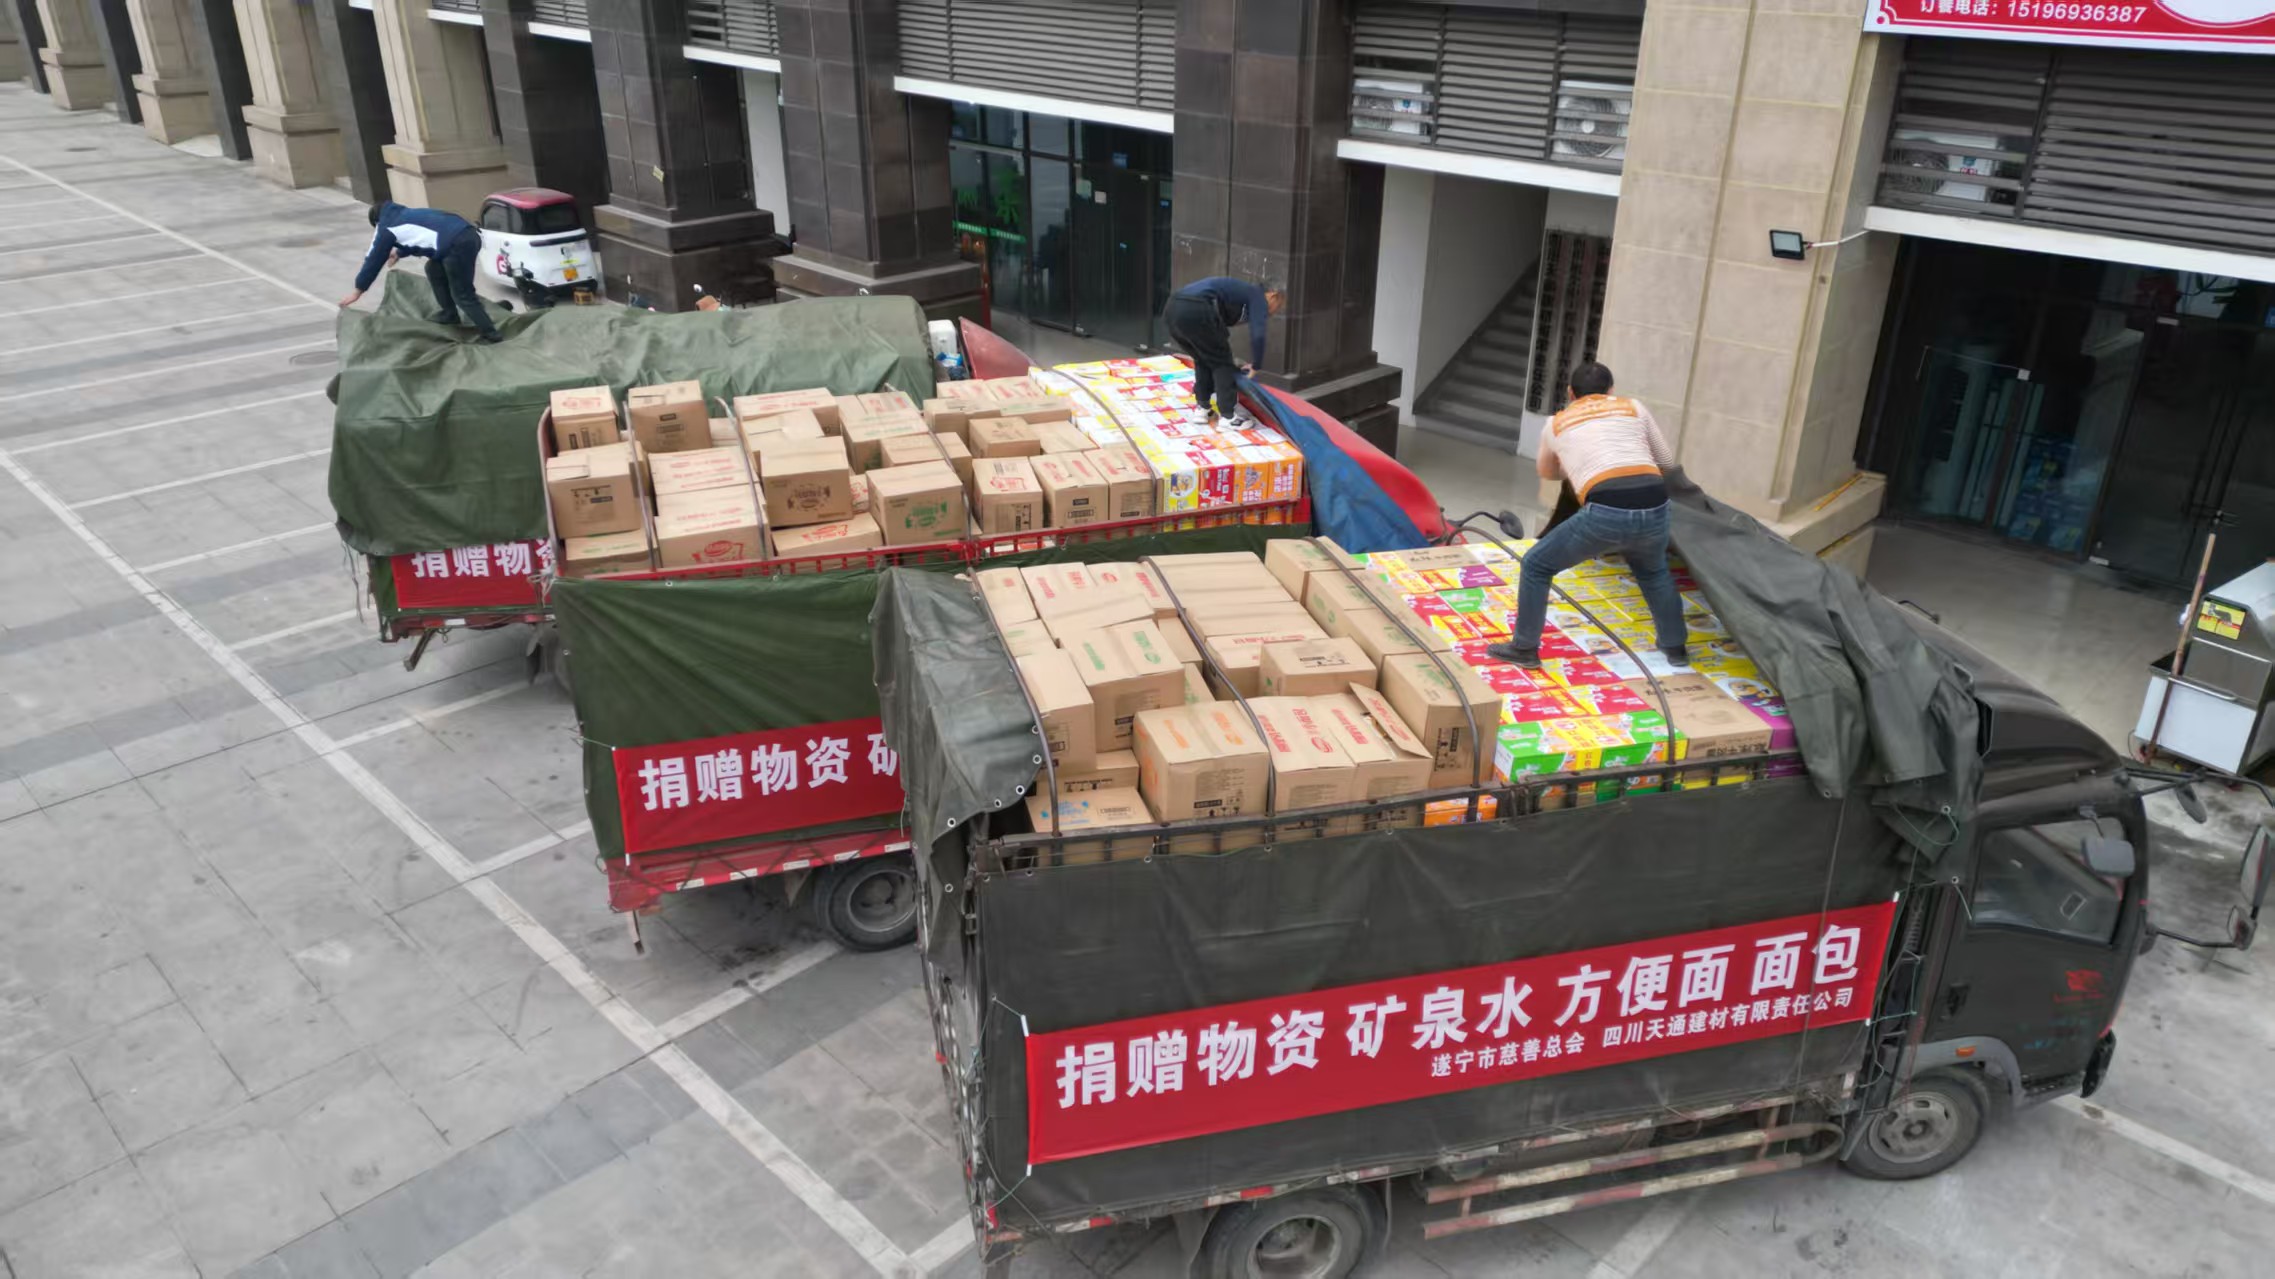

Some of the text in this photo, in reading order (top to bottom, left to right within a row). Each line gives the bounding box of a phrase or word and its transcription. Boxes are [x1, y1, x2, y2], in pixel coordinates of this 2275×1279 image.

[638, 736, 851, 811] 捐赠物资
[1055, 924, 1862, 1109] 捐赠物资 矿泉水 方便面 面包
[1430, 987, 1854, 1078] 遂宁市慈善总会 四川天通建材有限责任公司
